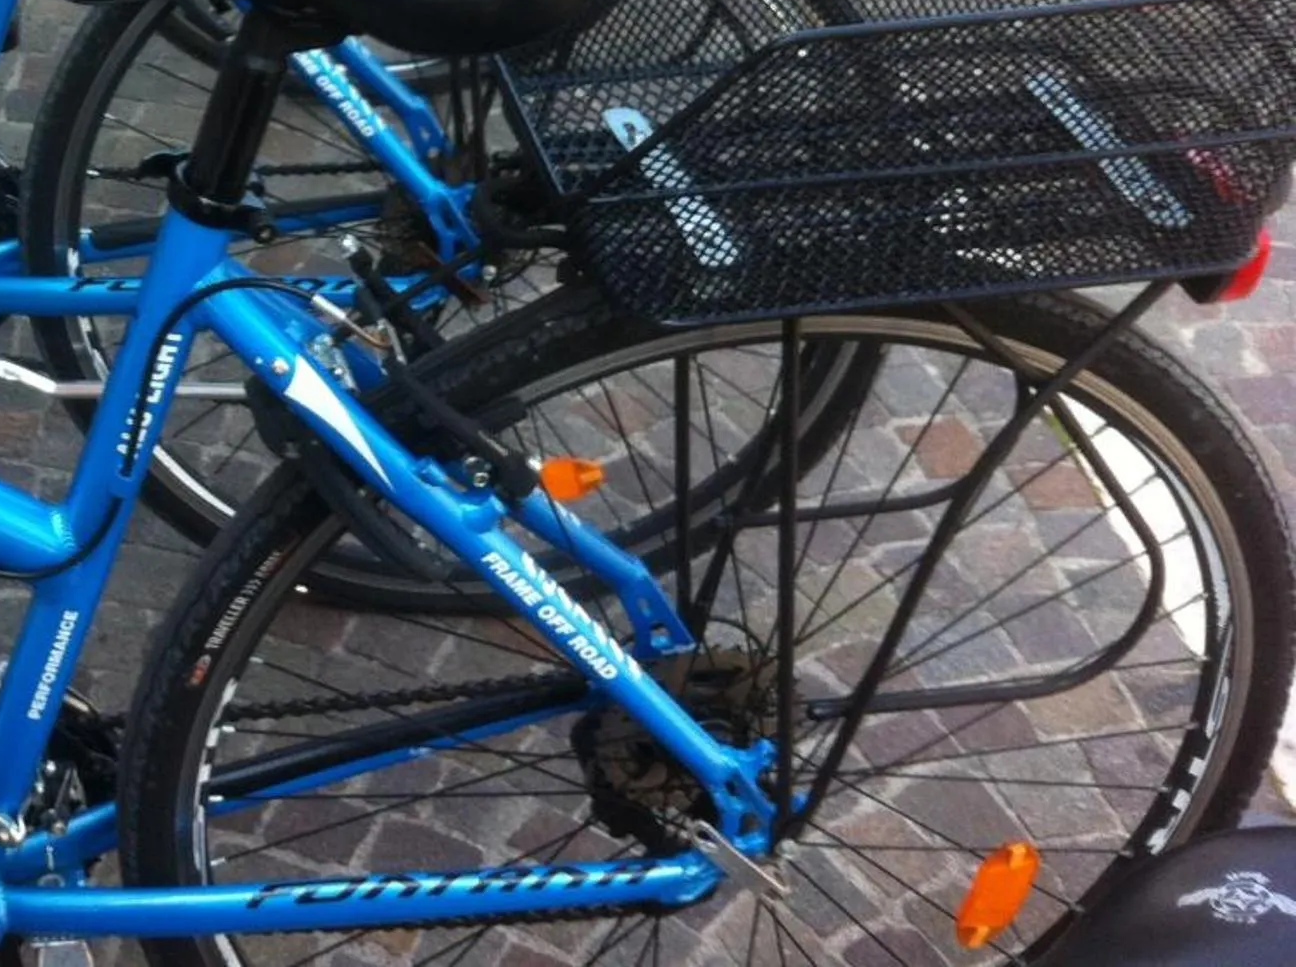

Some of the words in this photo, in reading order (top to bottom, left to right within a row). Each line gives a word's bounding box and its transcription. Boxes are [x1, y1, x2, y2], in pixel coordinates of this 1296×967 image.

[315, 74, 346, 101] OFF
[337, 99, 376, 137] ROAD
[26, 609, 80, 720] PERFORMANCE
[480, 551, 544, 607] FRAME
[536, 604, 577, 635] OFF
[566, 634, 618, 680] ROAD
